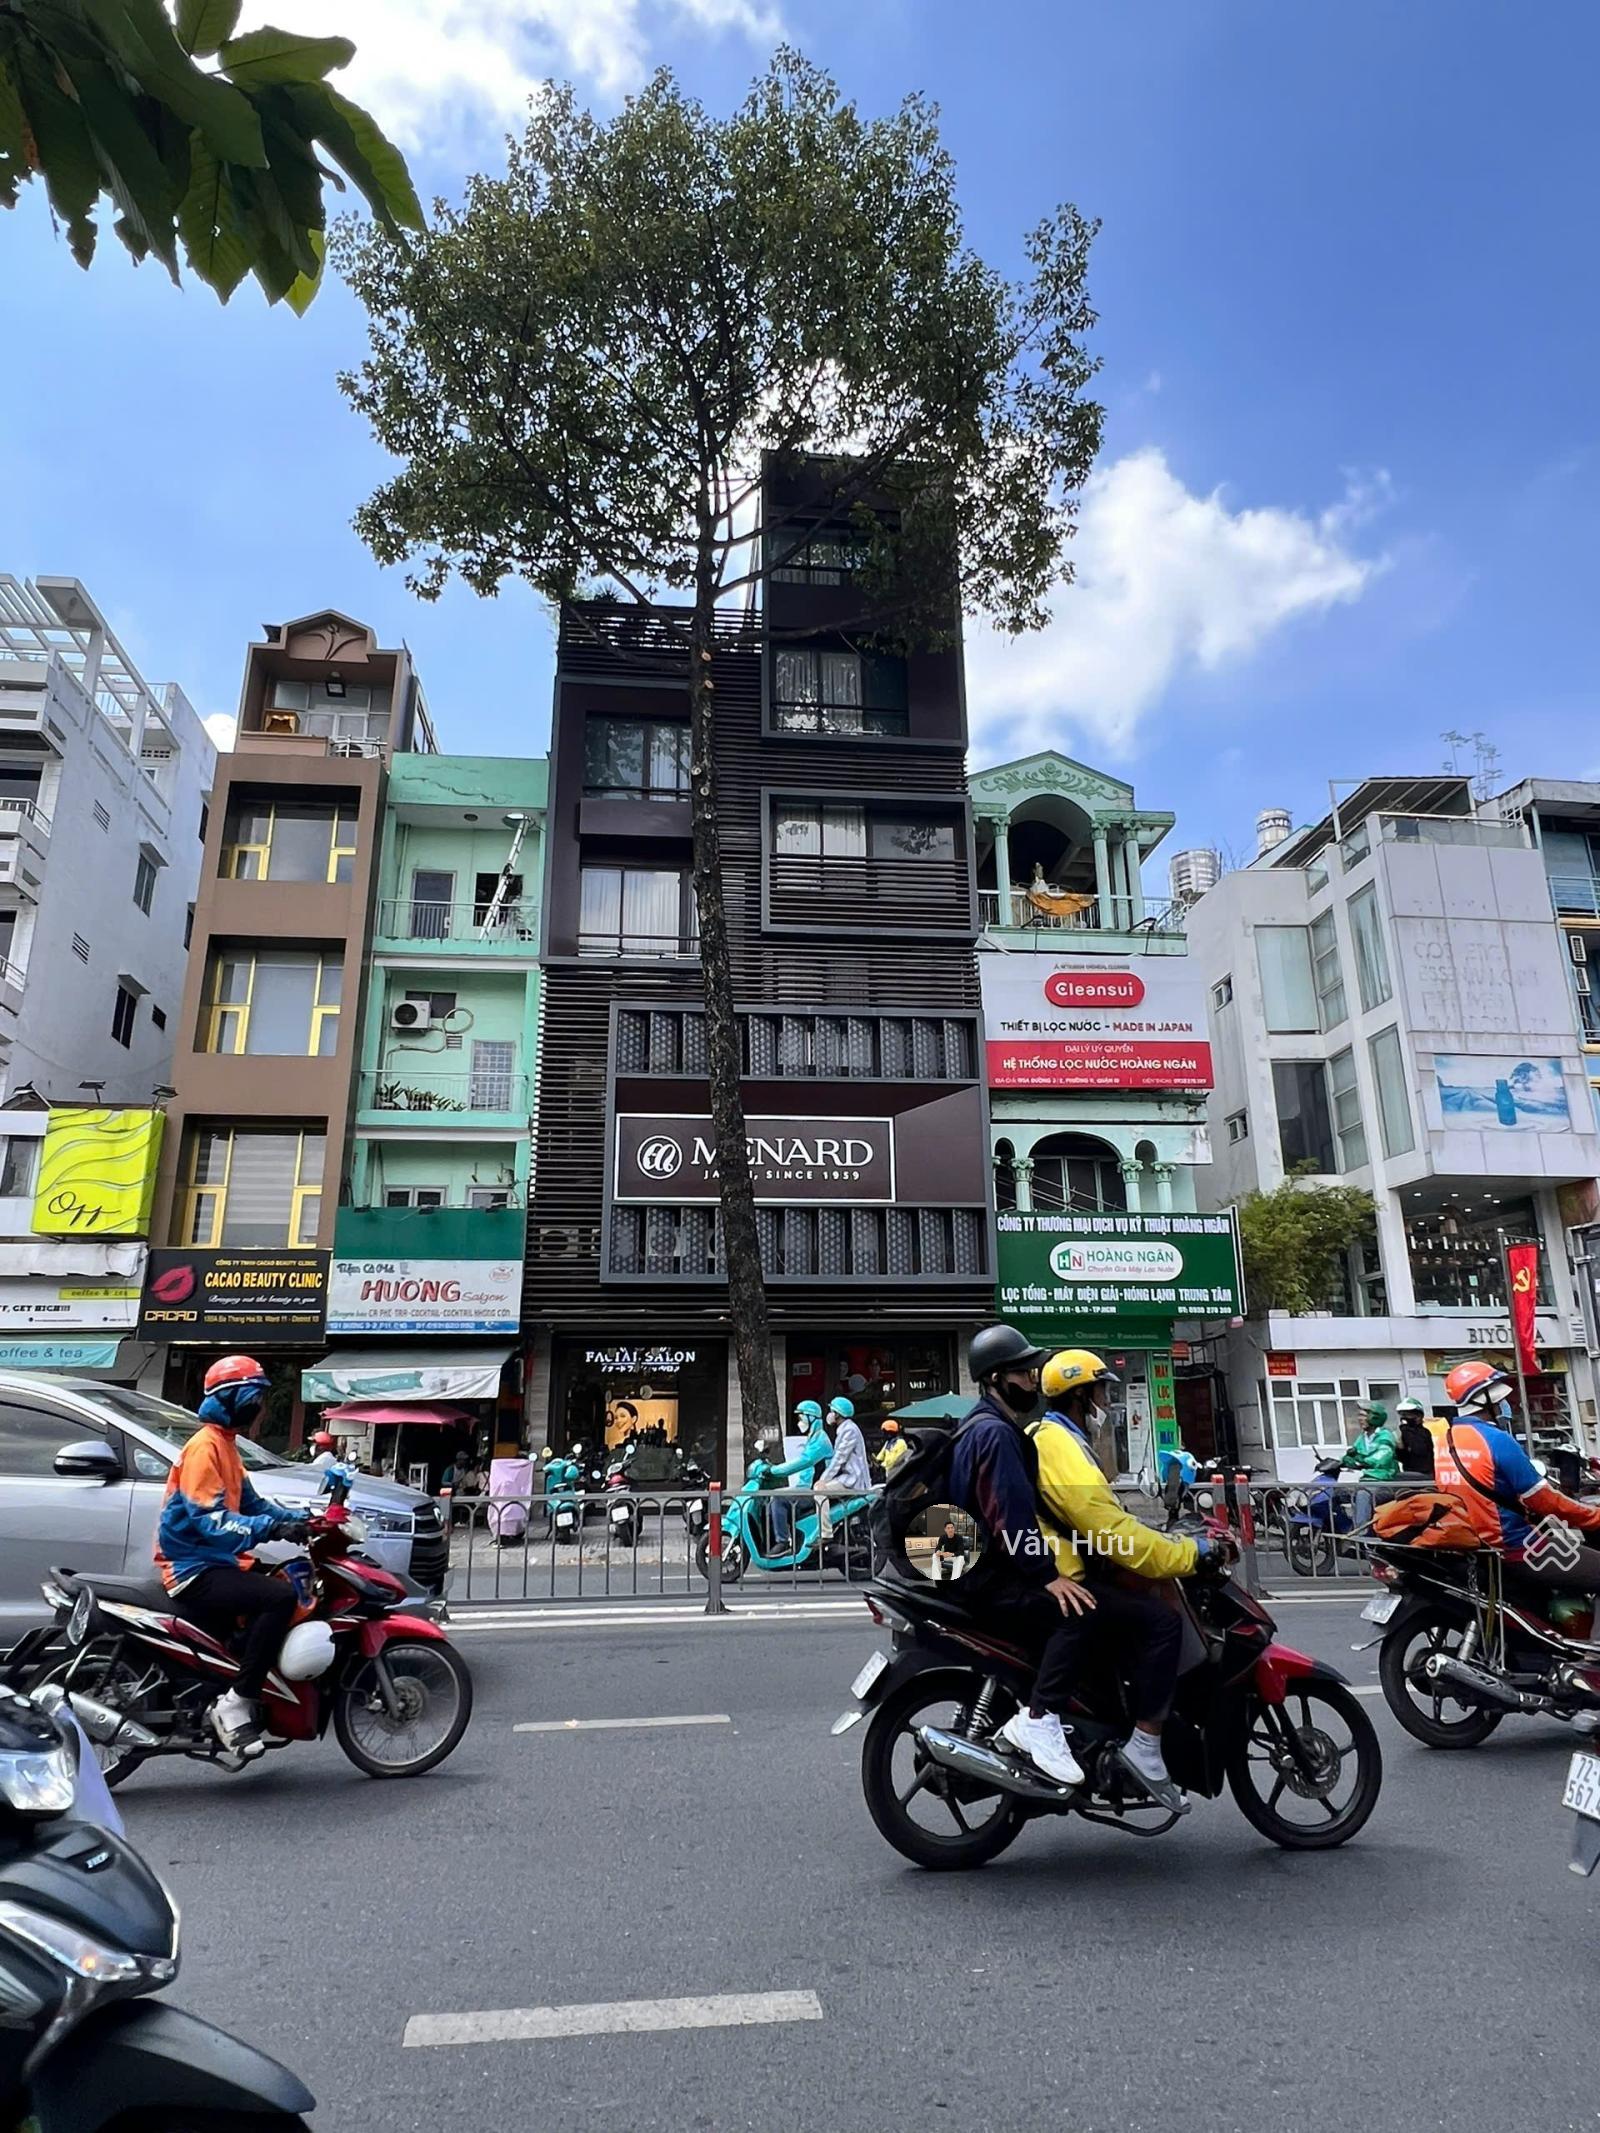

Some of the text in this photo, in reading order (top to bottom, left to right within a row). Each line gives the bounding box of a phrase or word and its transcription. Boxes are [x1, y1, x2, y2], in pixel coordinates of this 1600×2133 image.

[1055, 981, 1134, 997] Cleansui
[1000, 1018, 1030, 1031] THIẾT
[1043, 1021, 1067, 1034] LỌC
[1069, 1019, 1102, 1032] NƯỚC
[1113, 1022, 1144, 1032] MADE
[1145, 1022, 1156, 1032] IN
[1158, 1022, 1193, 1032] JAPAN
[1003, 1056, 1017, 1071] HỆ
[1018, 1055, 1058, 1069] THỐNG
[1059, 1058, 1084, 1071] LỌC
[1085, 1055, 1119, 1069] NƯỚC
[1120, 1056, 1162, 1069] HOÀNG
[766, 1171, 814, 1180] SINCE
[823, 1171, 861, 1180] 1959
[997, 1214, 1022, 1231] CÔNG
[1022, 1217, 1035, 1231] TY
[1036, 1216, 1072, 1232] THƯƠNG
[1073, 1217, 1091, 1234] MẠI
[1092, 1217, 1114, 1235] DỊCH
[1115, 1217, 1129, 1235] VỤ
[1143, 1215, 1171, 1236] THUẬT
[1172, 1215, 1204, 1233] HOÀNG
[1086, 1247, 1174, 1262] HOÀNG NGÂN
[204, 1271, 323, 1289] CACAO BEAUTY CLINIC
[360, 1277, 461, 1303] HƯƠNG
[1001, 1287, 1020, 1303] LỌC
[1053, 1286, 1074, 1301] MÁY
[1150, 1288, 1176, 1304] LẠNH
[1178, 1288, 1209, 1302] TRUNG
[1211, 1286, 1232, 1302] TÂM
[43, 1347, 53, 1359] &
[59, 1347, 84, 1359] tea
[644, 1350, 696, 1363] SALON
